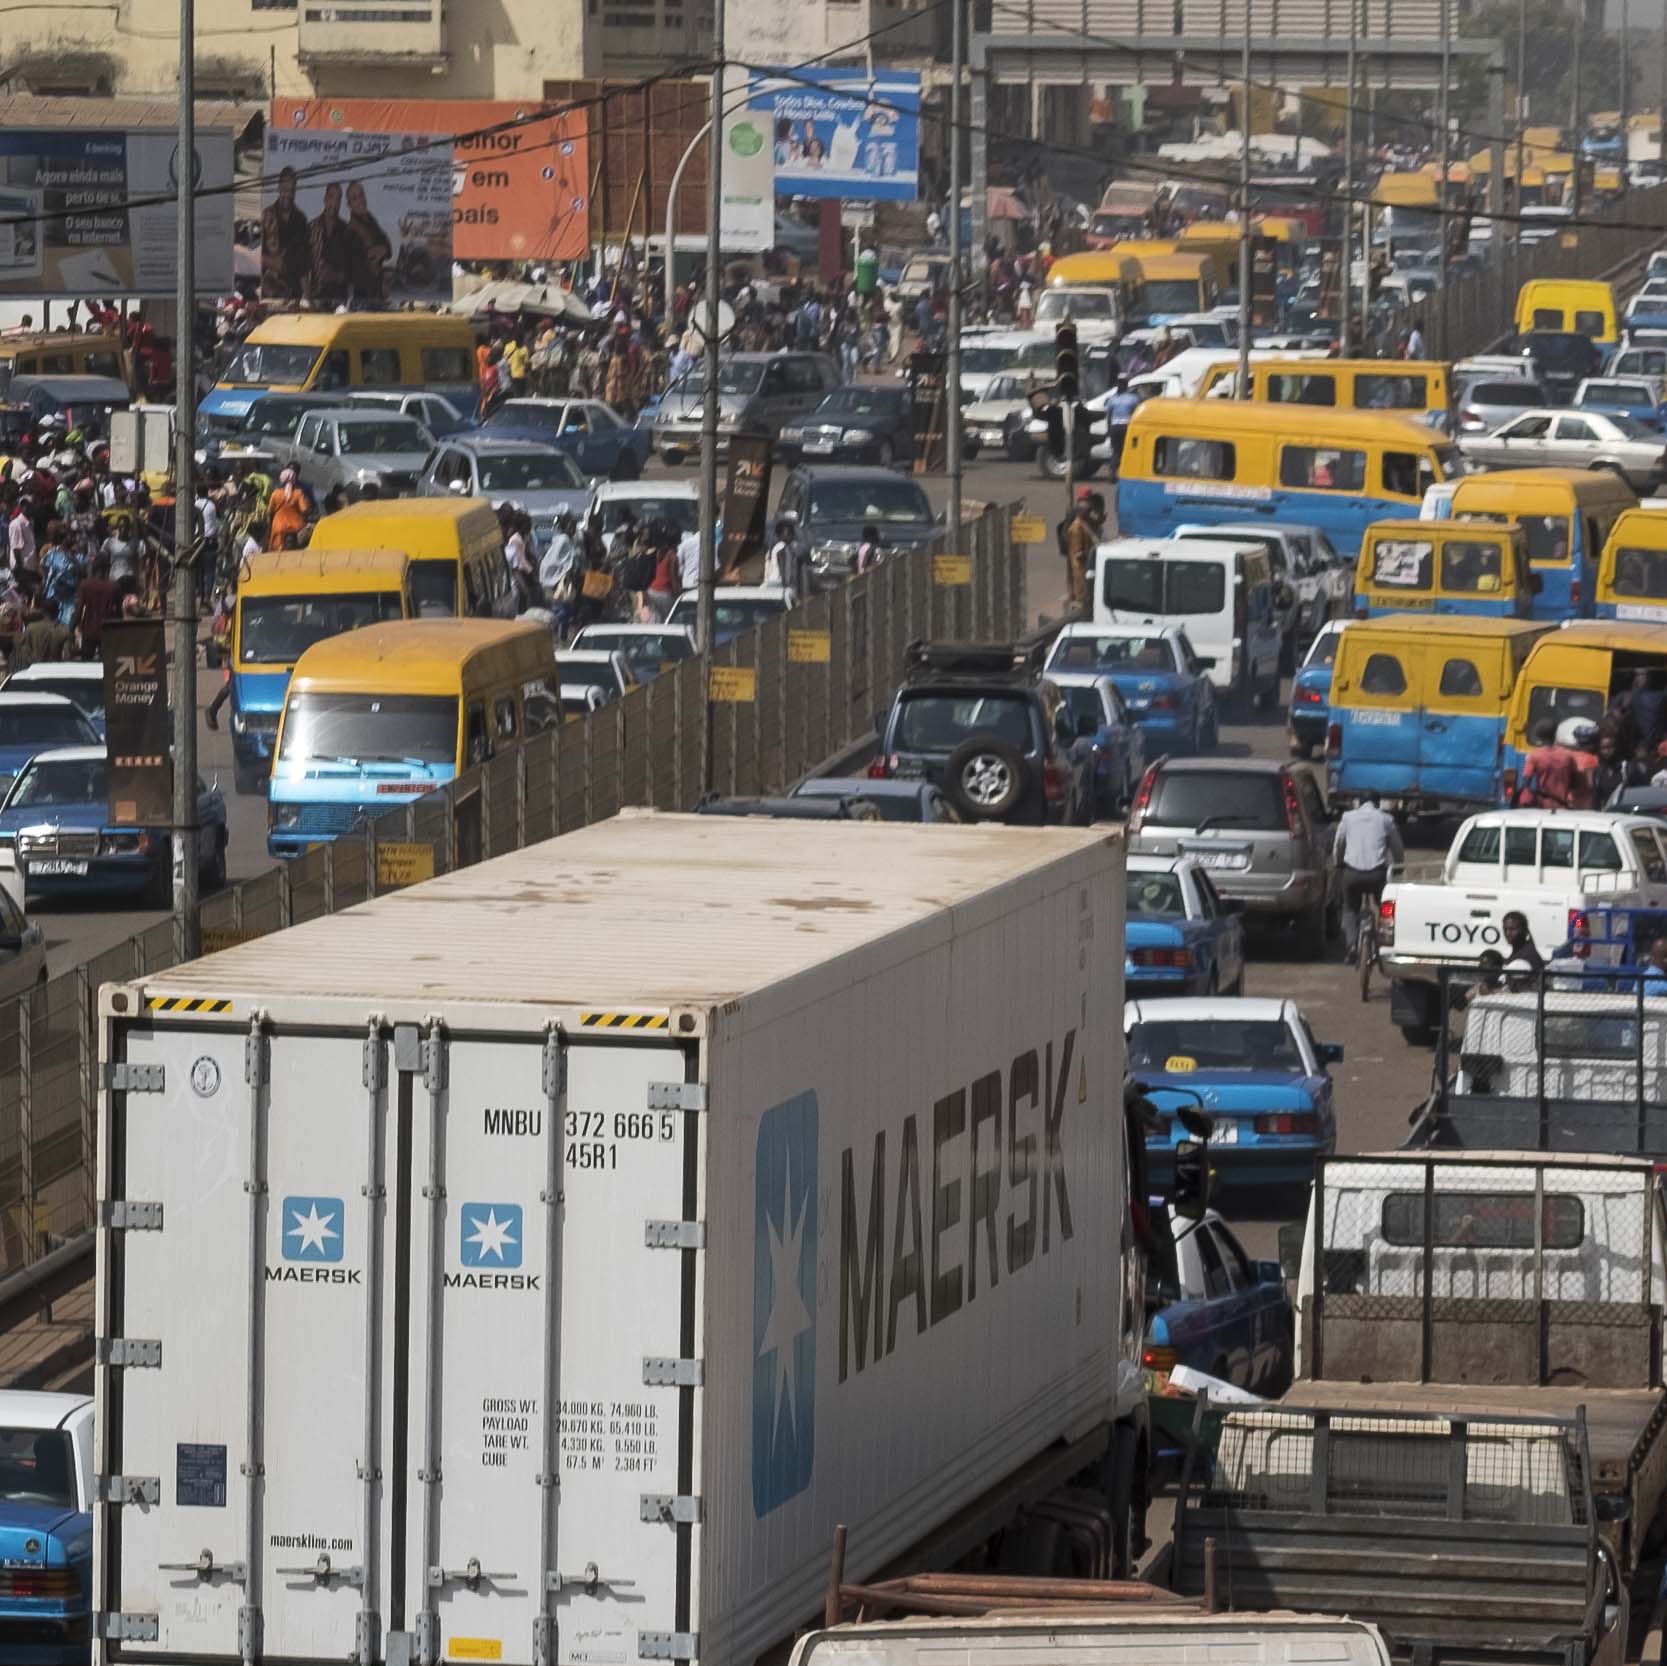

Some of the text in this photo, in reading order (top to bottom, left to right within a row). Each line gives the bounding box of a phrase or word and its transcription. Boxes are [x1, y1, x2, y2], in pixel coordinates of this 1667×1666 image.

[453, 133, 522, 150] elhor
[36, 169, 124, 184] Agora ainda mais
[472, 171, 508, 187] em
[66, 191, 94, 207] perto
[66, 216, 123, 231] O seu banco
[115, 680, 158, 693] Orange
[115, 693, 155, 706] Money
[484, 1109, 674, 1141] MNBU 372 666 5
[566, 1144, 618, 1169] 45R1
[838, 1028, 1076, 1385] MAERSK
[265, 1266, 361, 1284] MAERSK
[443, 1272, 541, 1291] MAERSK
[483, 1398, 517, 1414] GROSS
[519, 1399, 538, 1415] WT.
[590, 1402, 606, 1416] KG.
[644, 1404, 658, 1419] LB.
[482, 1417, 528, 1431] PAYLOAD
[590, 1420, 606, 1434] KG.
[484, 1434, 508, 1448] TARE
[511, 1435, 529, 1449] WT.
[590, 1438, 605, 1452] KG.
[482, 1452, 508, 1467] CUBE
[270, 1533, 353, 1550] maerskline.com
